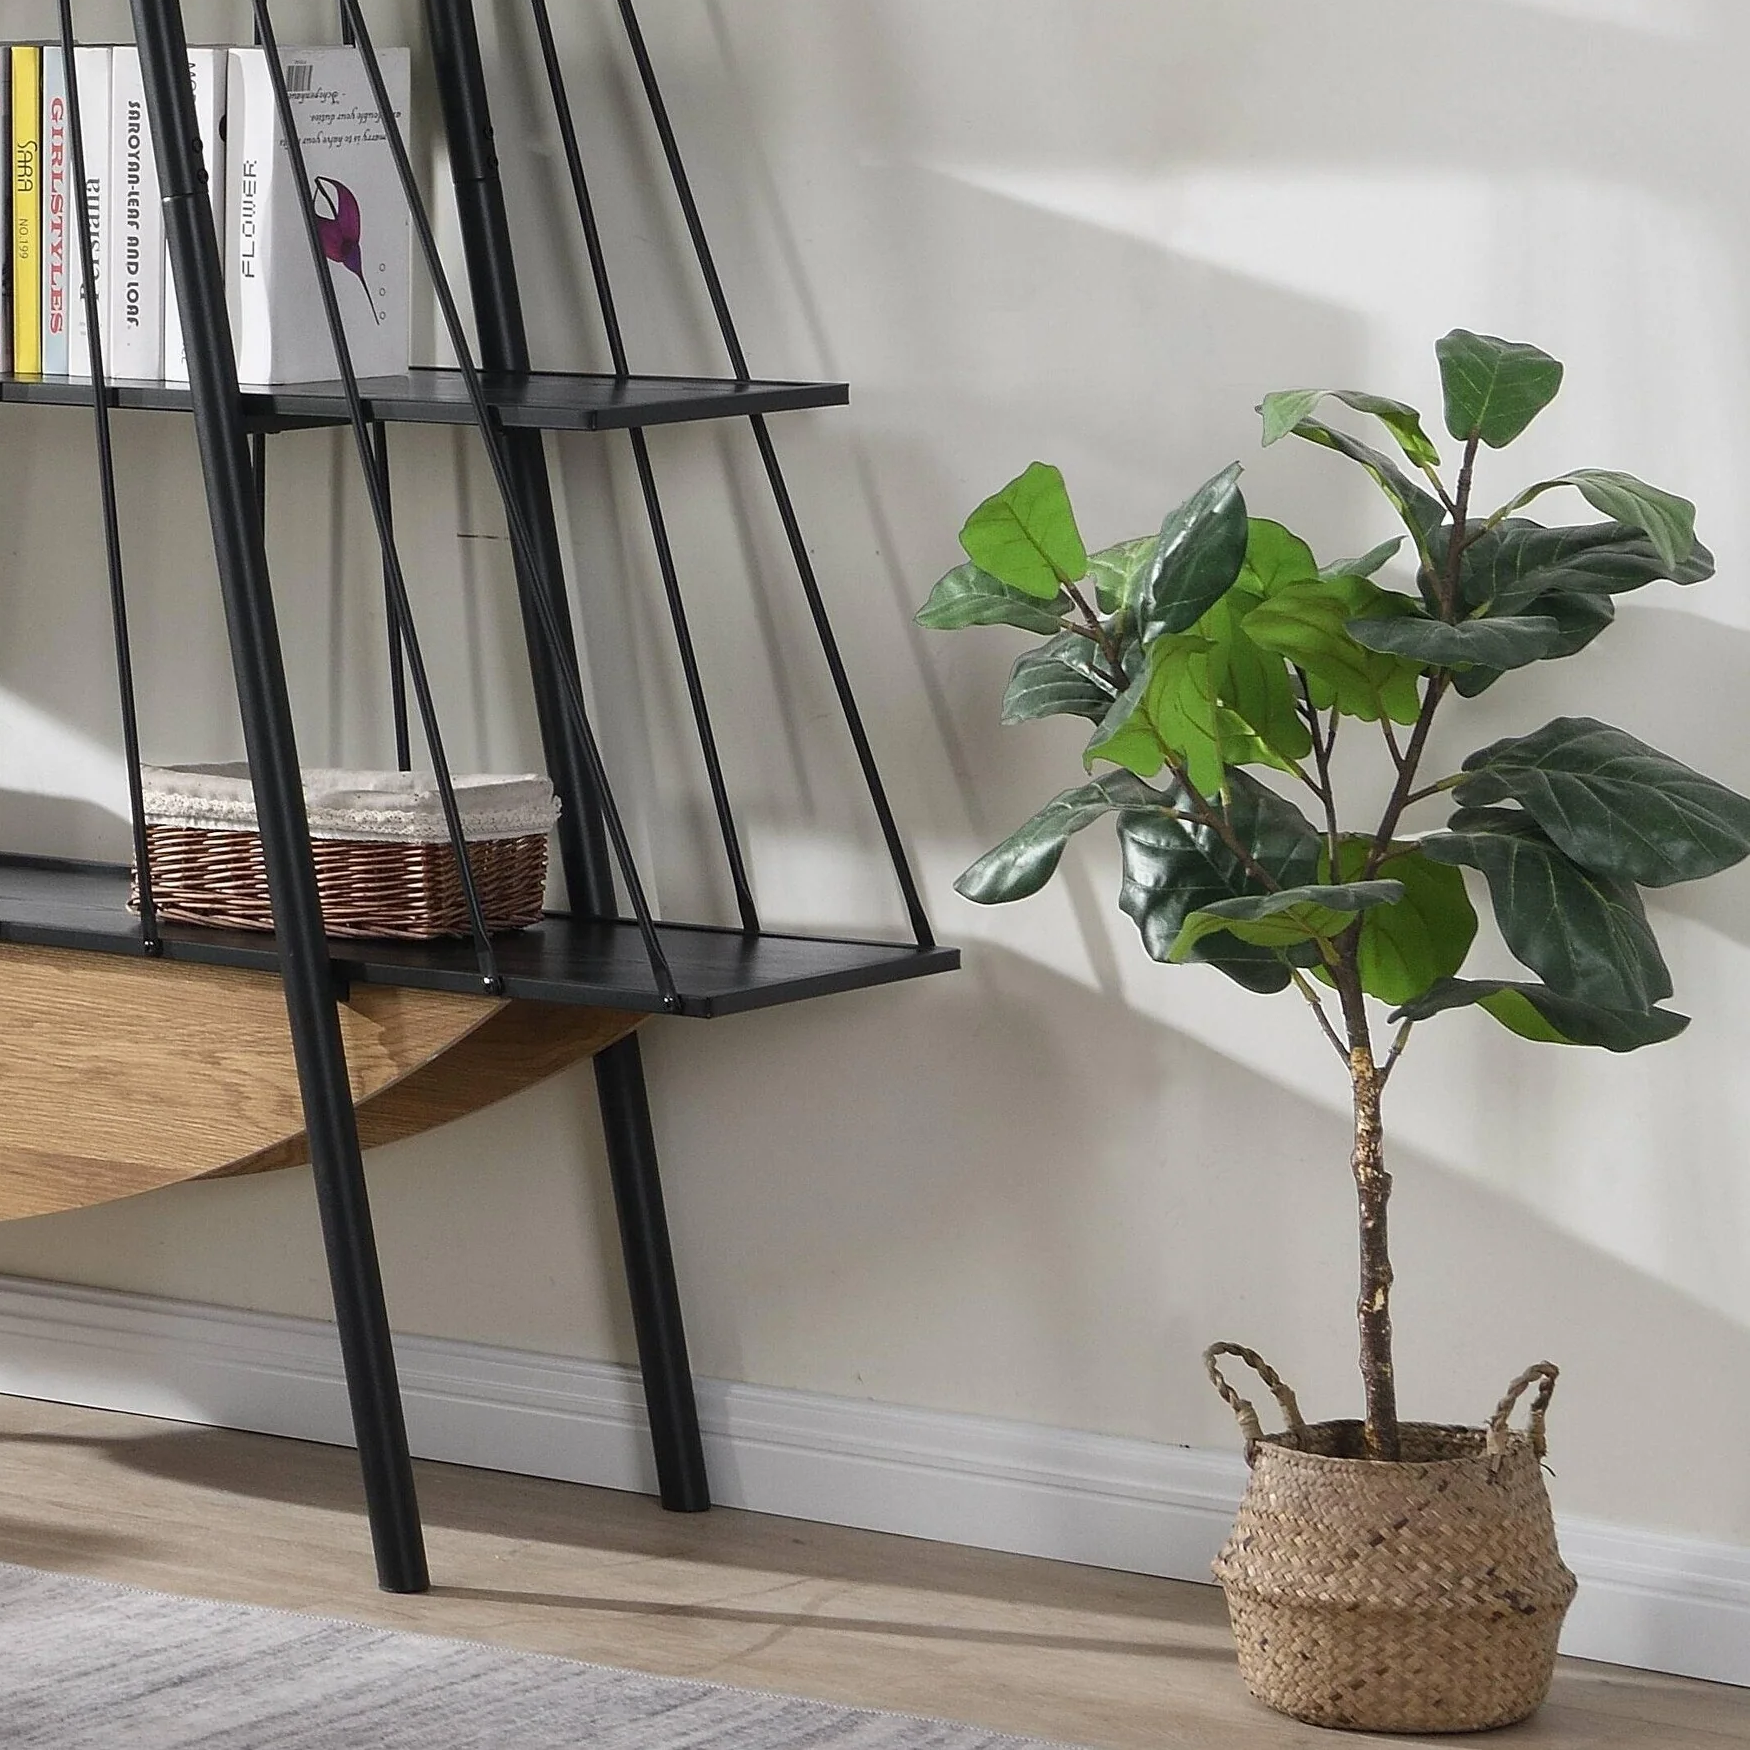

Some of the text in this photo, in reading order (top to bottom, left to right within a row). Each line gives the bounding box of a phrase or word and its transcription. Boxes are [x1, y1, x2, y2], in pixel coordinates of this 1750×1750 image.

[18, 218, 29, 259] NO.199
[50, 97, 64, 334] GIRLSTYLES
[242, 160, 257, 278] FLOWER
[126, 236, 140, 275] AND
